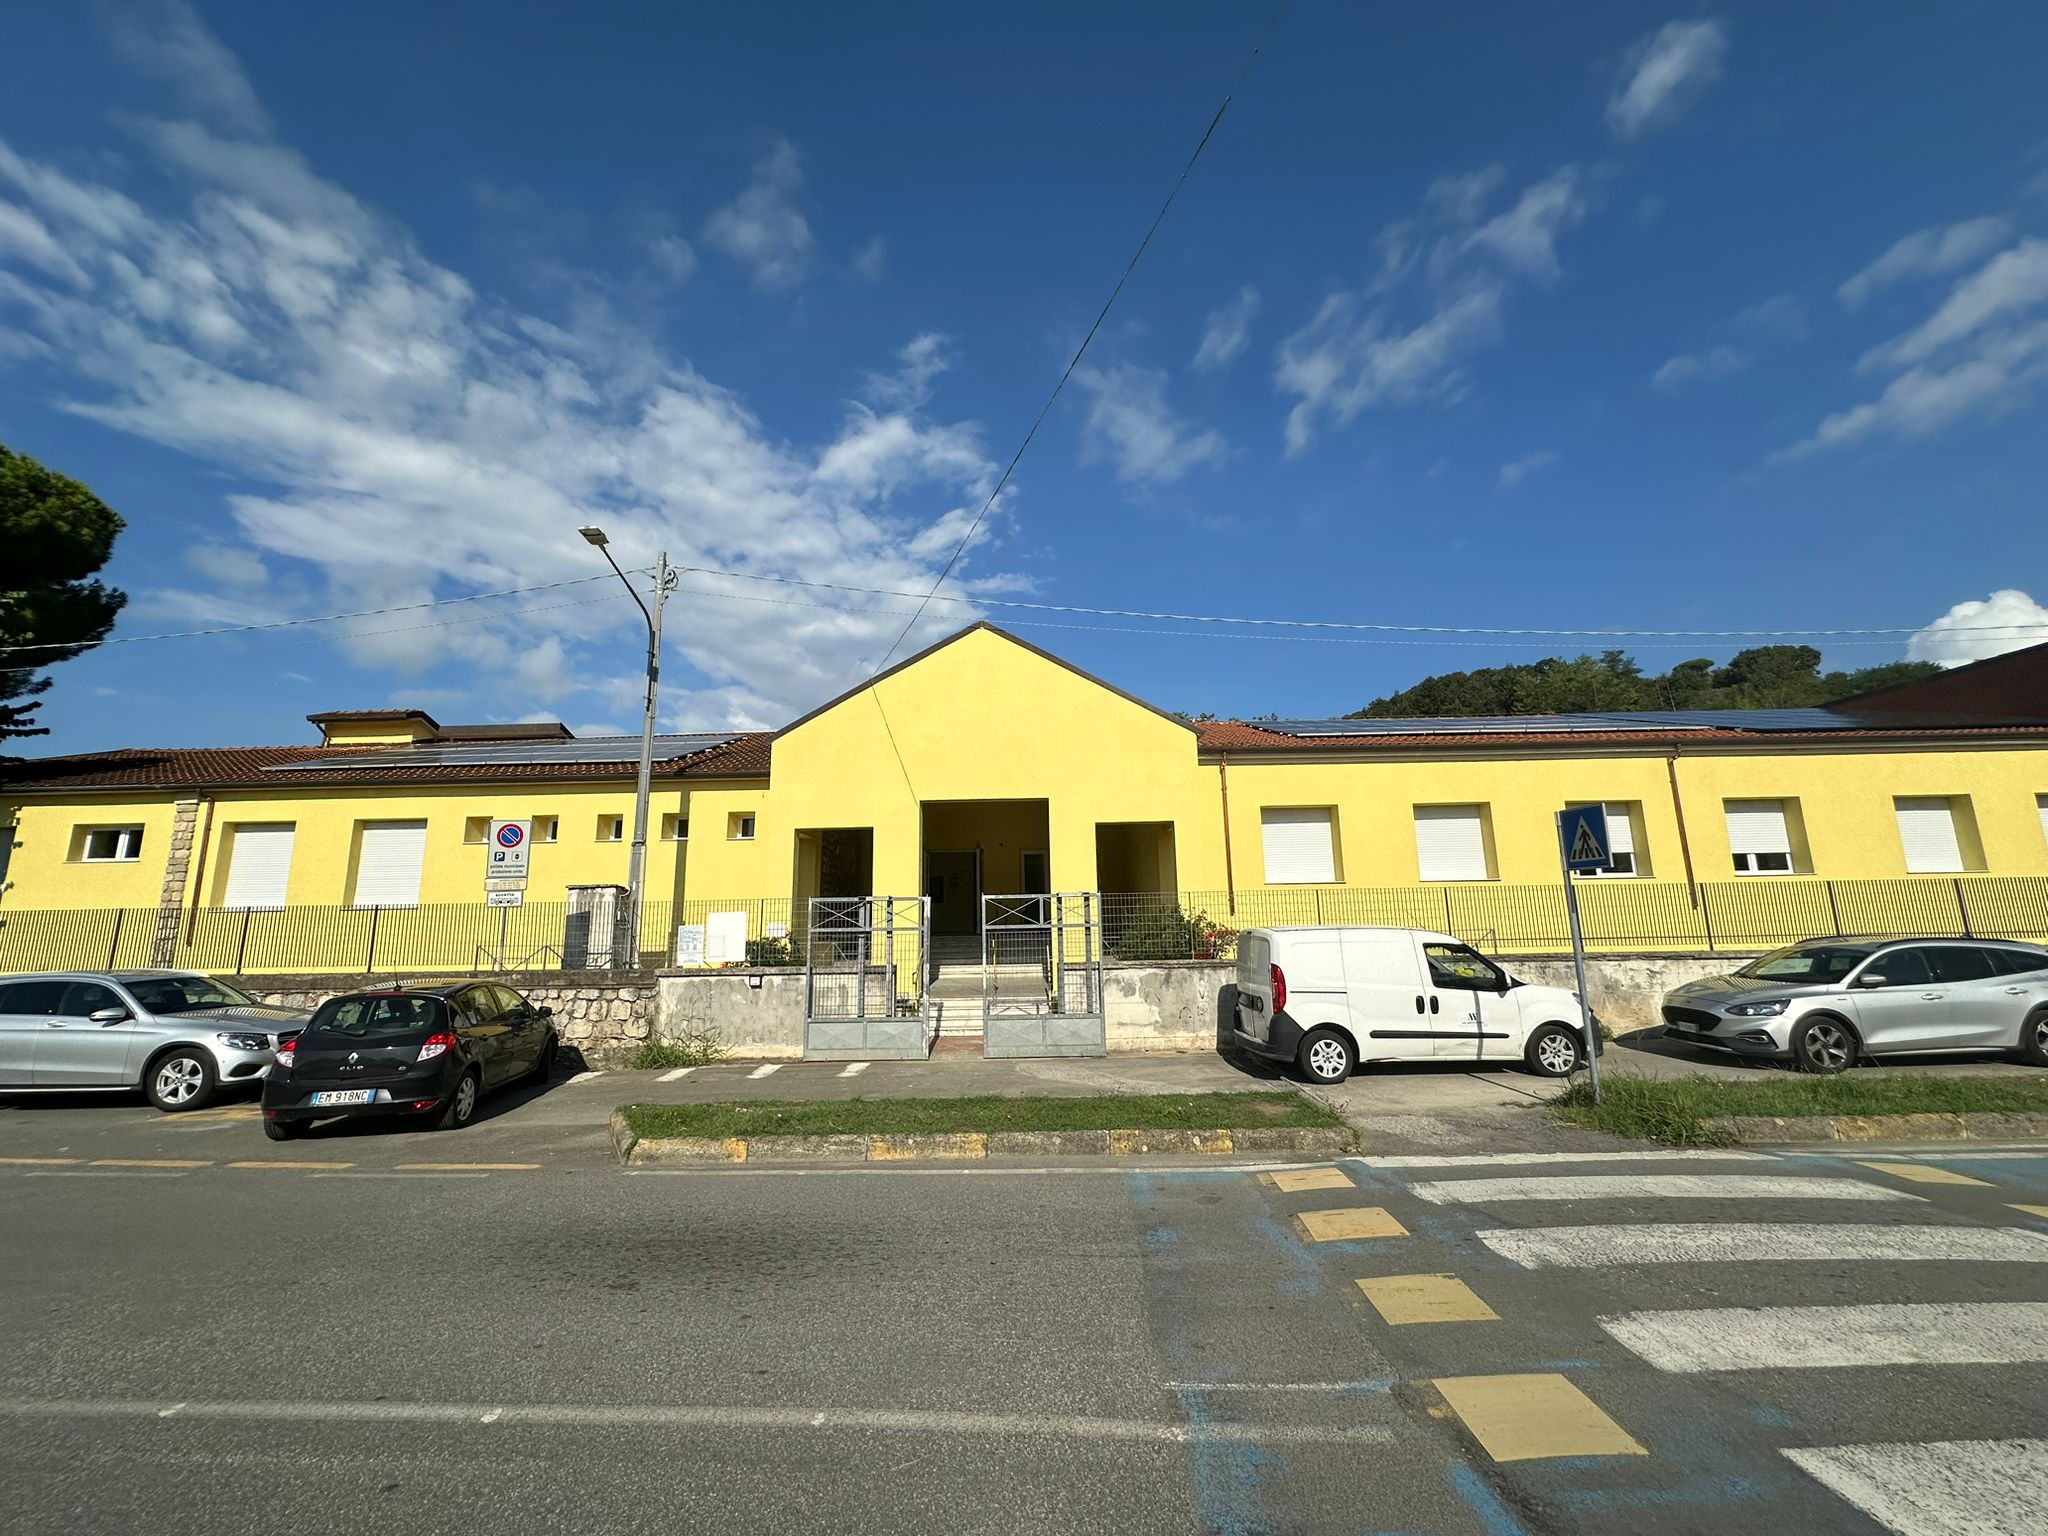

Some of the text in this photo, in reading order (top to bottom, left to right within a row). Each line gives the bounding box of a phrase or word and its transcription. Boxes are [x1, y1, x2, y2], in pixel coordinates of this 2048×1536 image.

[495, 852, 504, 861] P
[319, 1091, 368, 1103] EM 918NC
